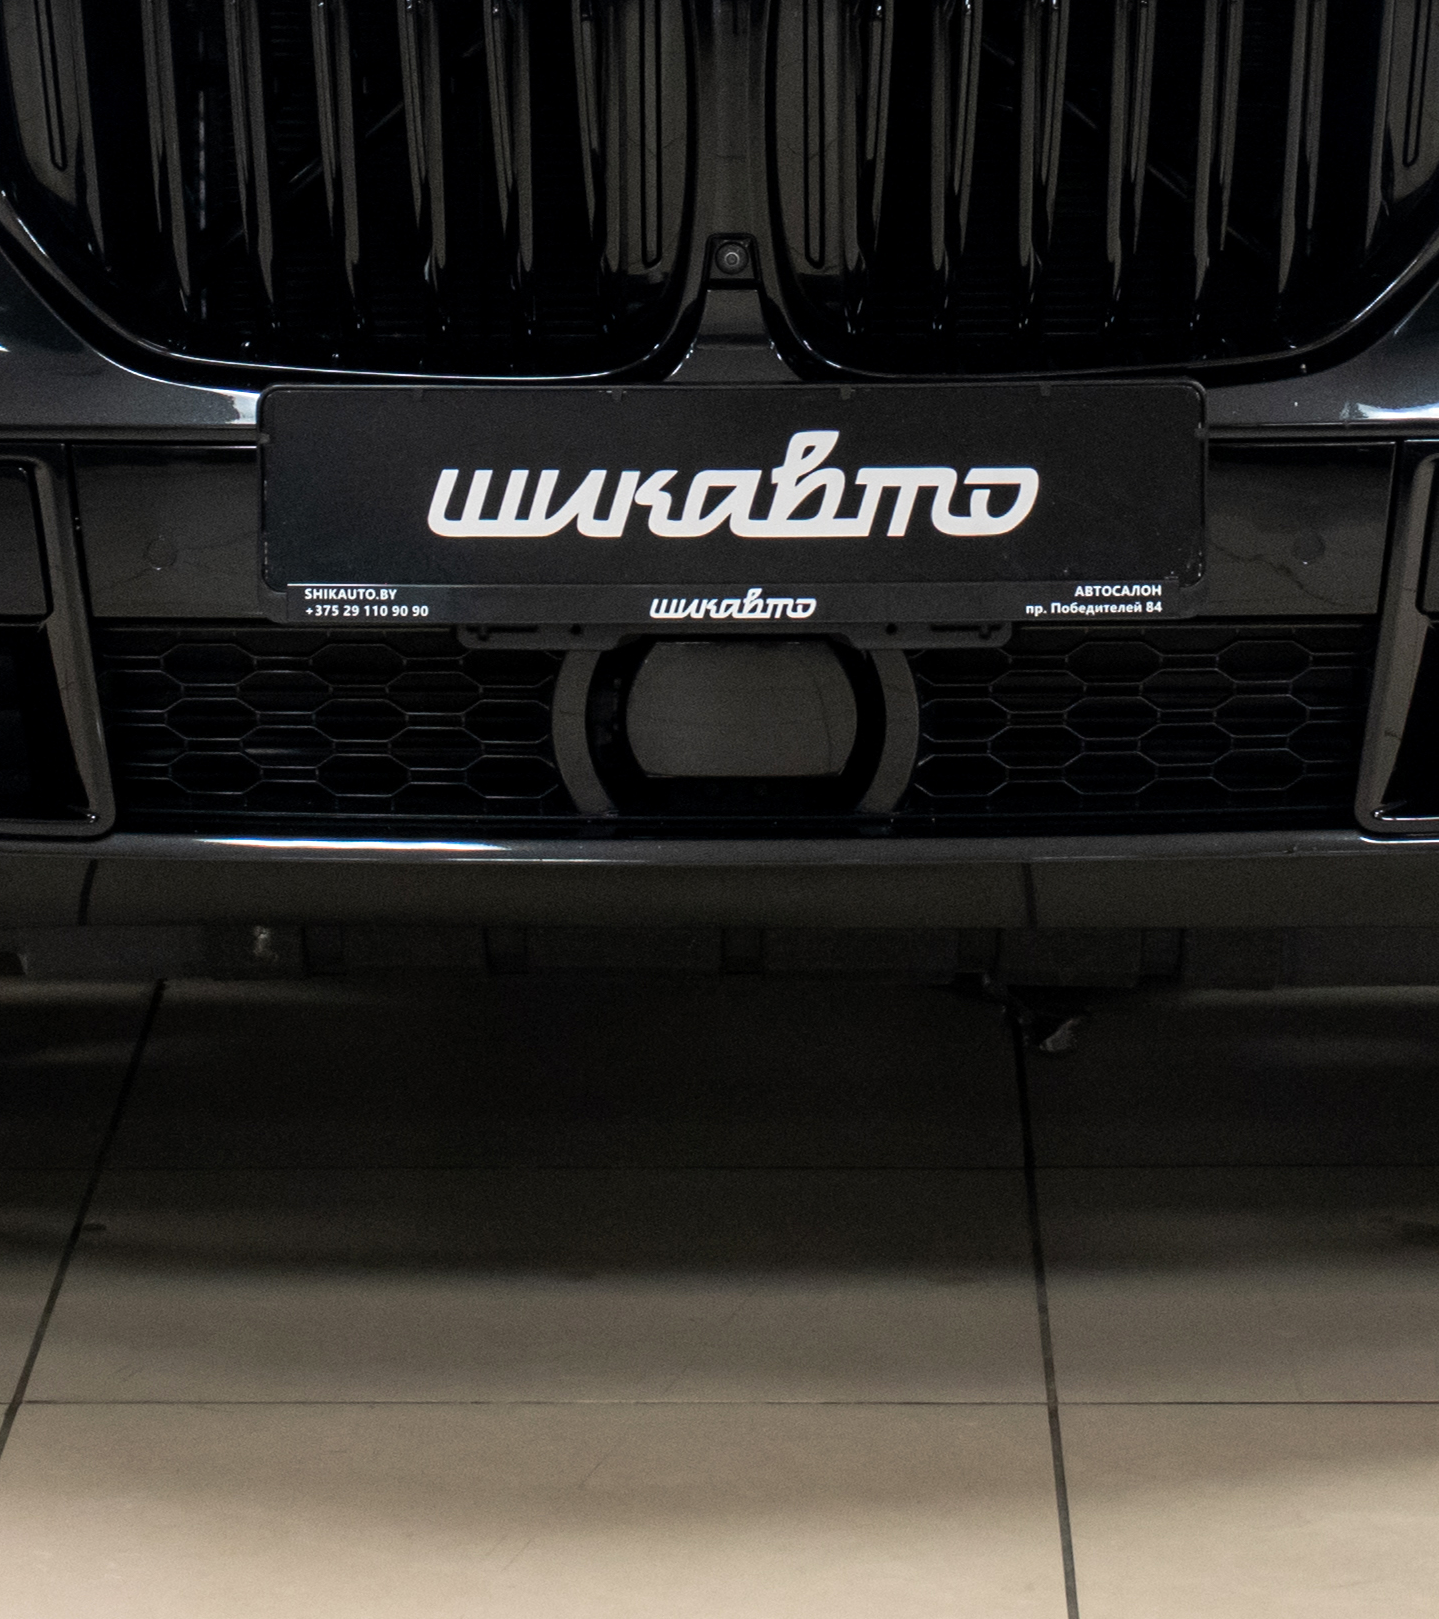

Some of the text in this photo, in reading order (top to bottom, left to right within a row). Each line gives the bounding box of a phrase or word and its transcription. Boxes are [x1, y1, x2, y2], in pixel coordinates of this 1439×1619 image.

[427, 430, 1039, 538] шикавто
[305, 588, 397, 600] SHIKAUTO.BY
[1075, 585, 1161, 596] АВТОСАЛОН
[650, 588, 817, 618] шикавто
[1026, 601, 1162, 617] пр. Победителей 84
[306, 605, 429, 616] +375 29 110 90 90
